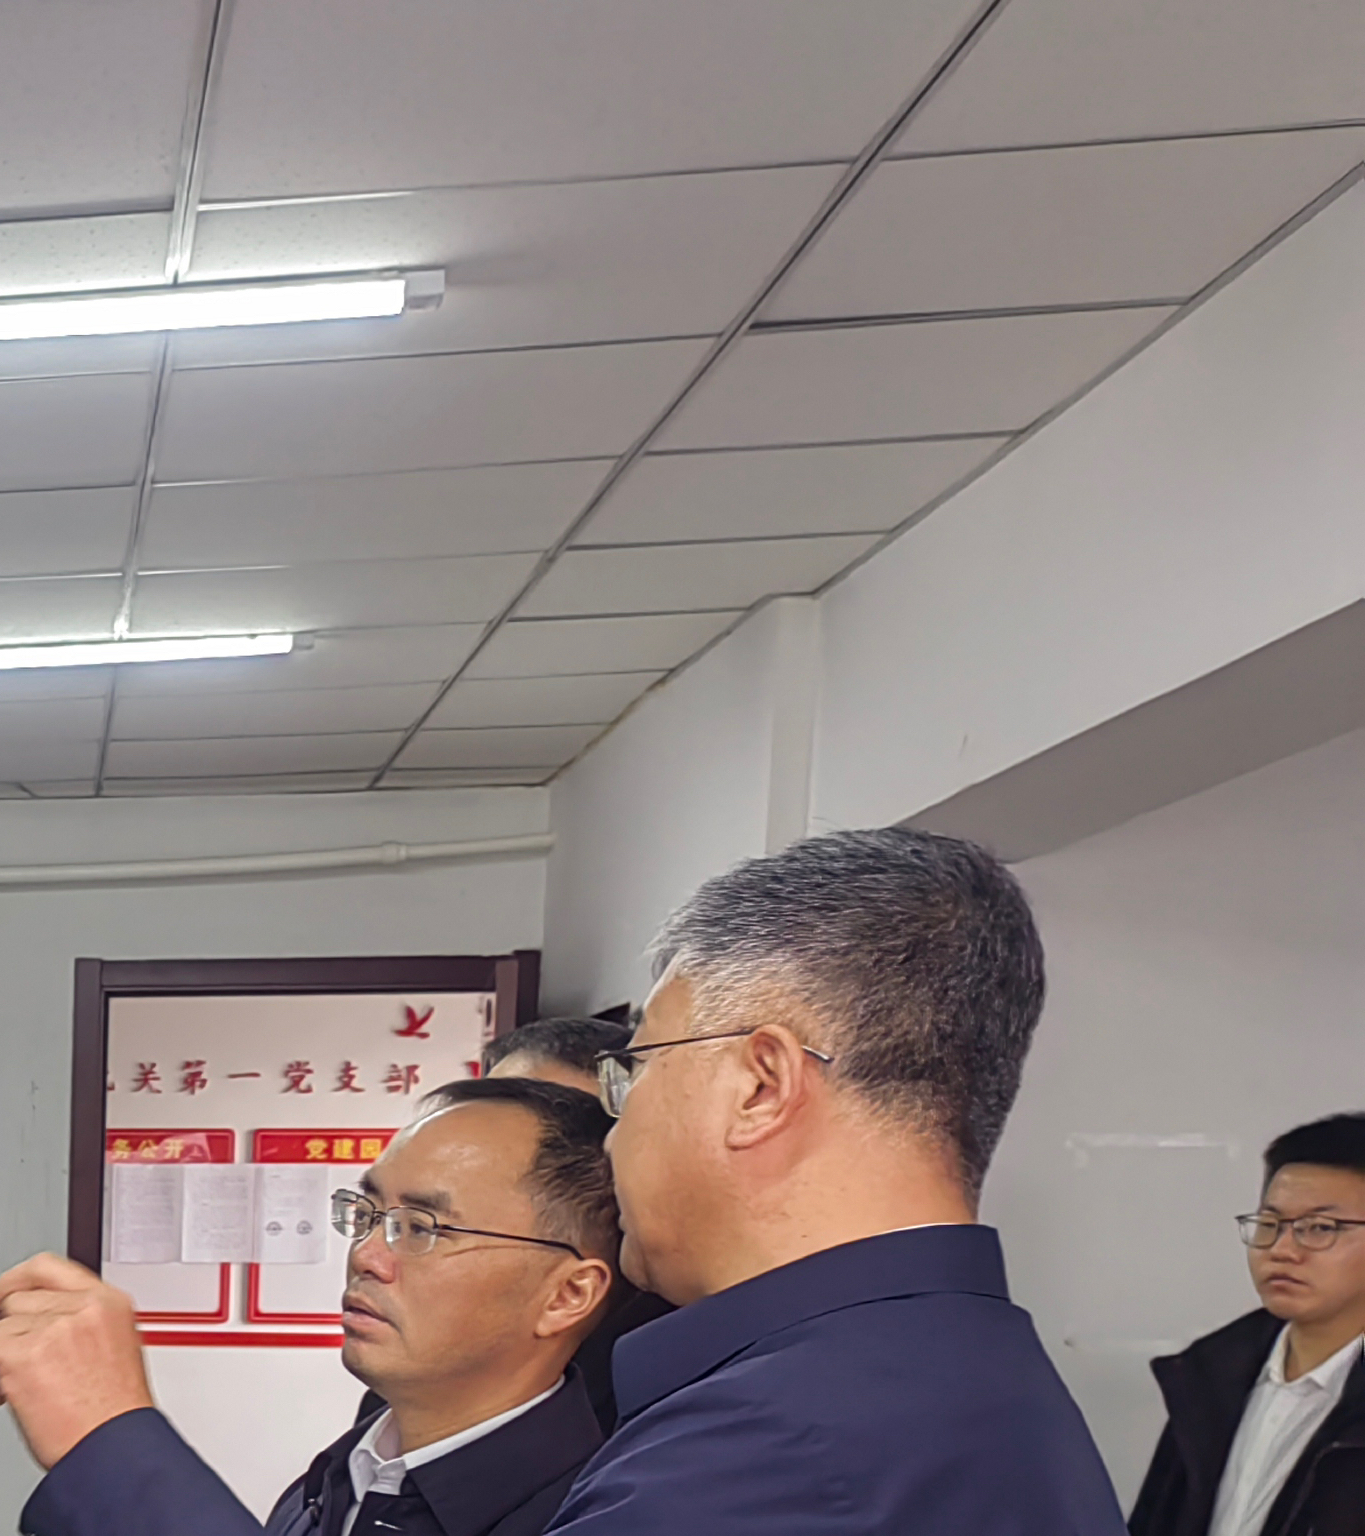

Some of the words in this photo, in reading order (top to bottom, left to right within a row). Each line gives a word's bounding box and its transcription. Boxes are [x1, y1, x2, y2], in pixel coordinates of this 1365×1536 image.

[106, 1059, 421, 1096] 关第一党支部
